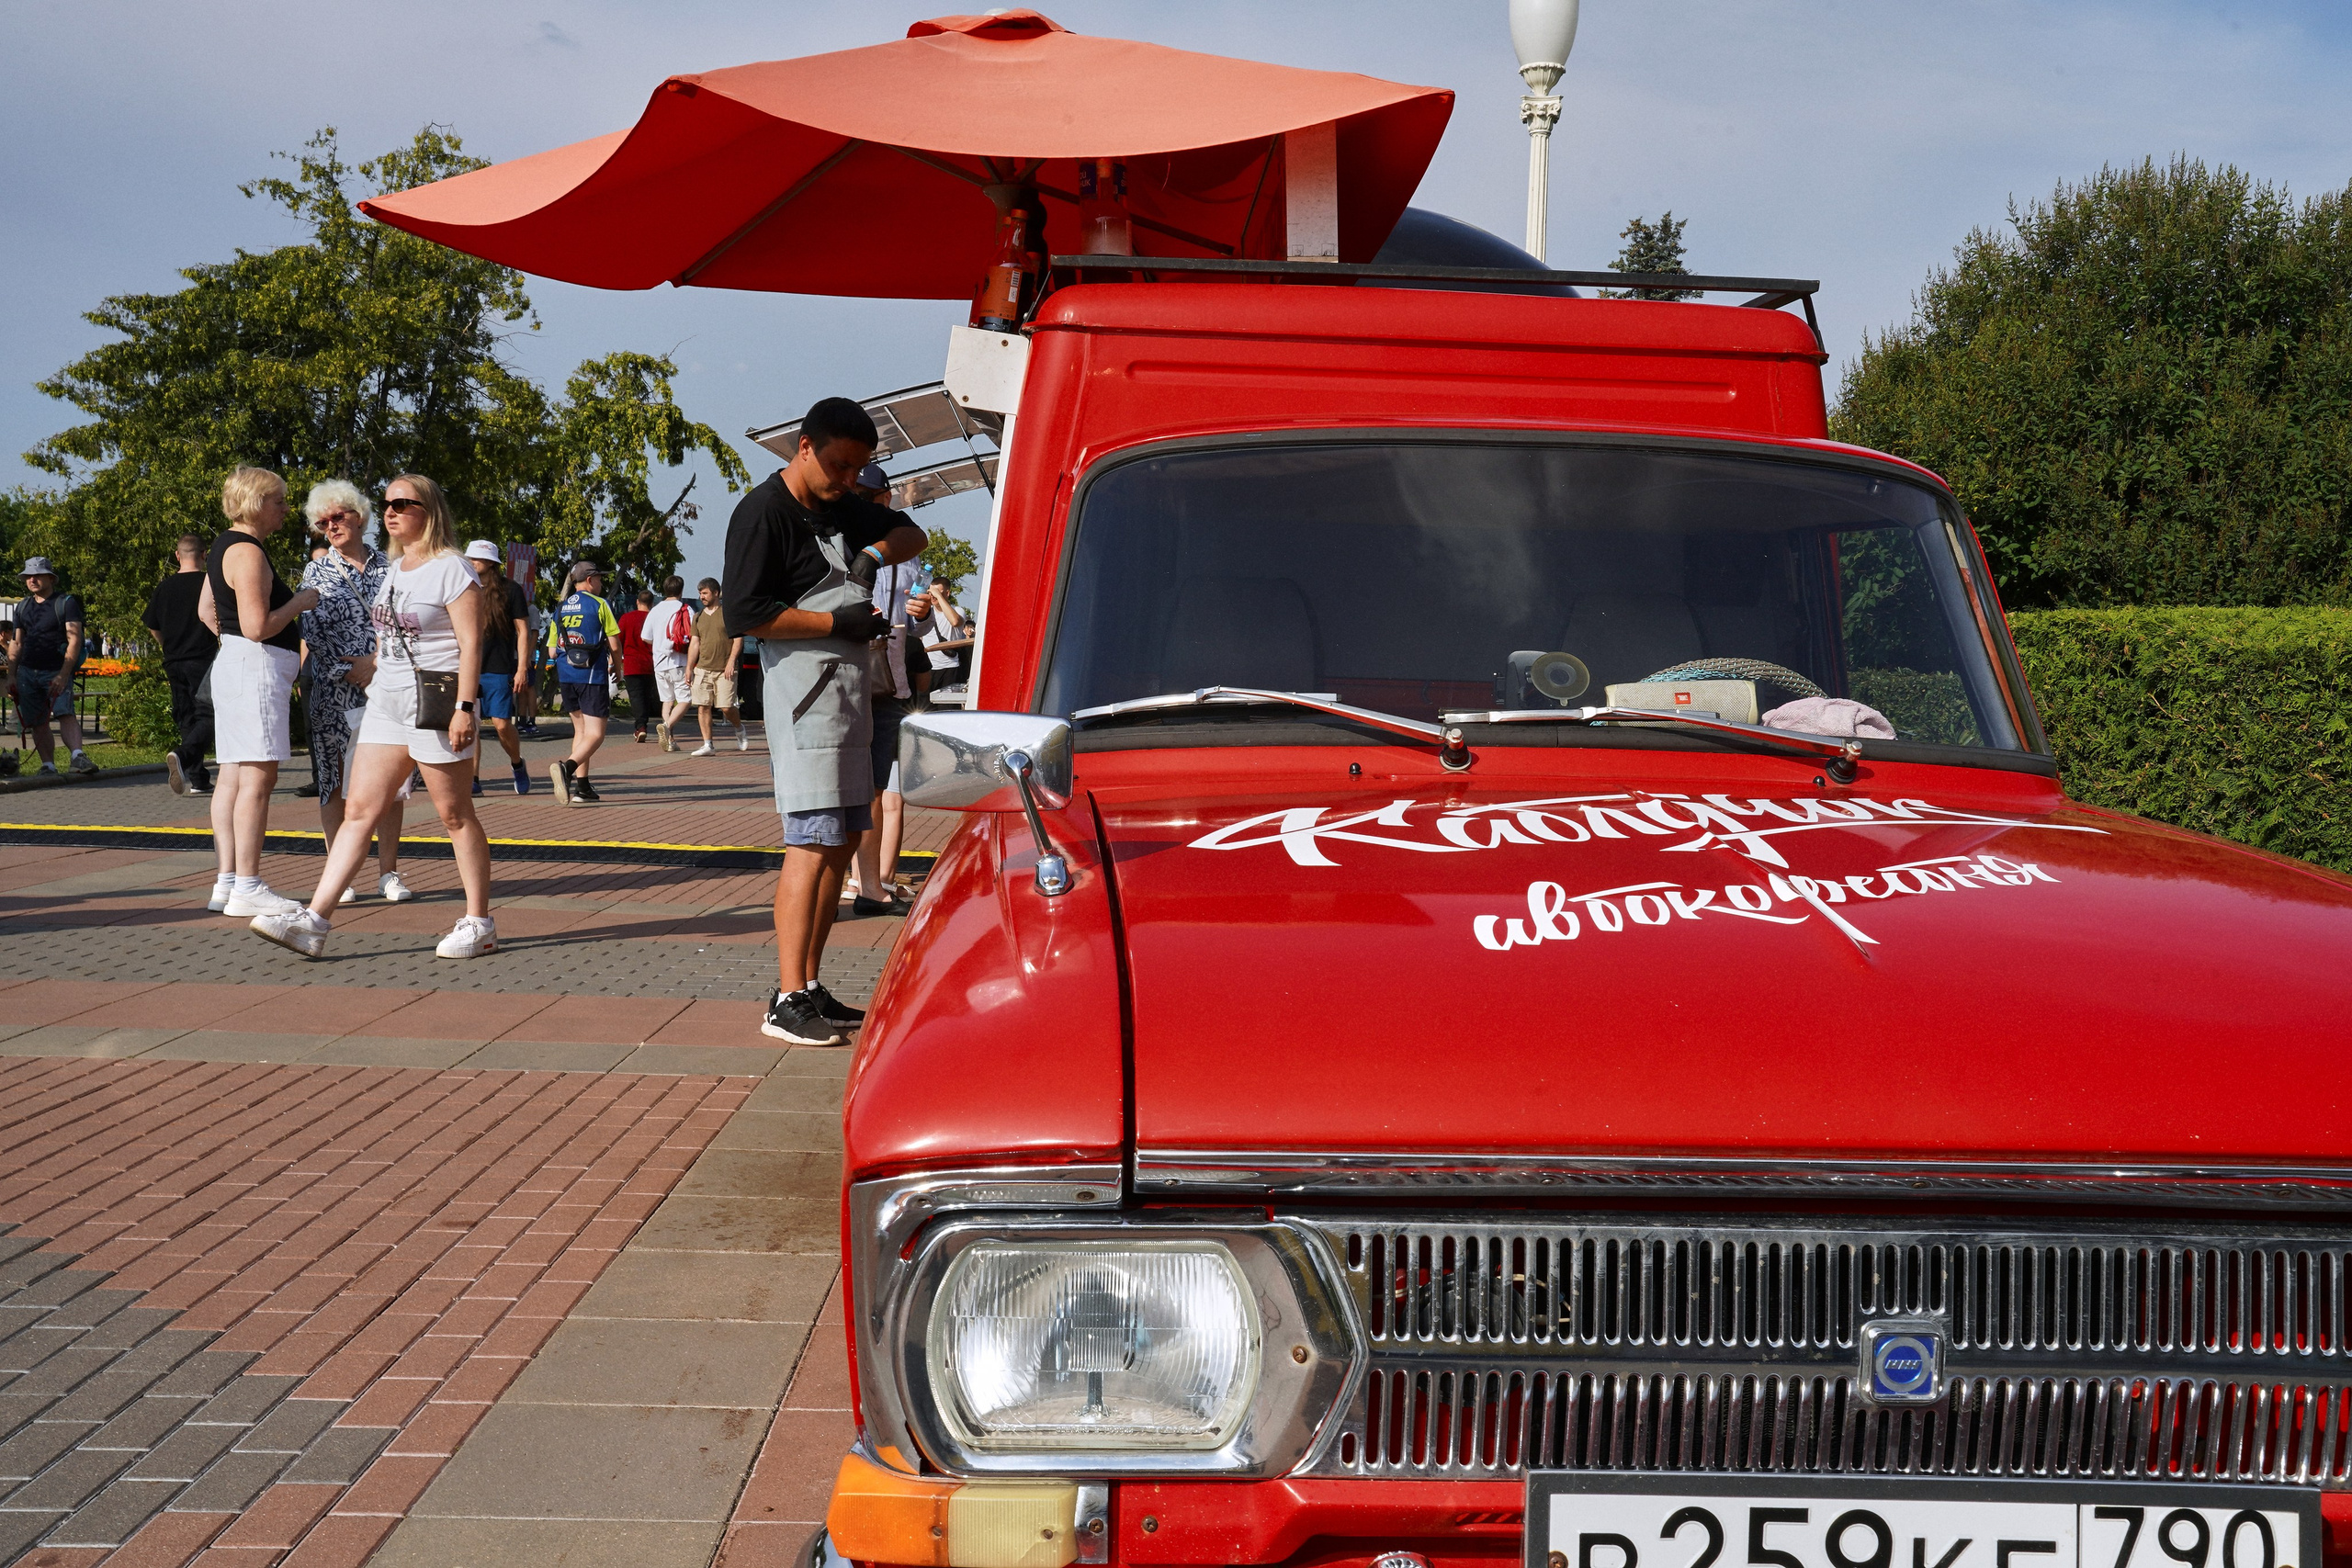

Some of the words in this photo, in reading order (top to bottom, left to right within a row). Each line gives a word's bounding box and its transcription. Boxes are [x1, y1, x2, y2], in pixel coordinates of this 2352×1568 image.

[561, 615, 583, 628] 46
[1474, 855, 2062, 951] автокофейня
[2094, 1506, 2276, 1568] 790
